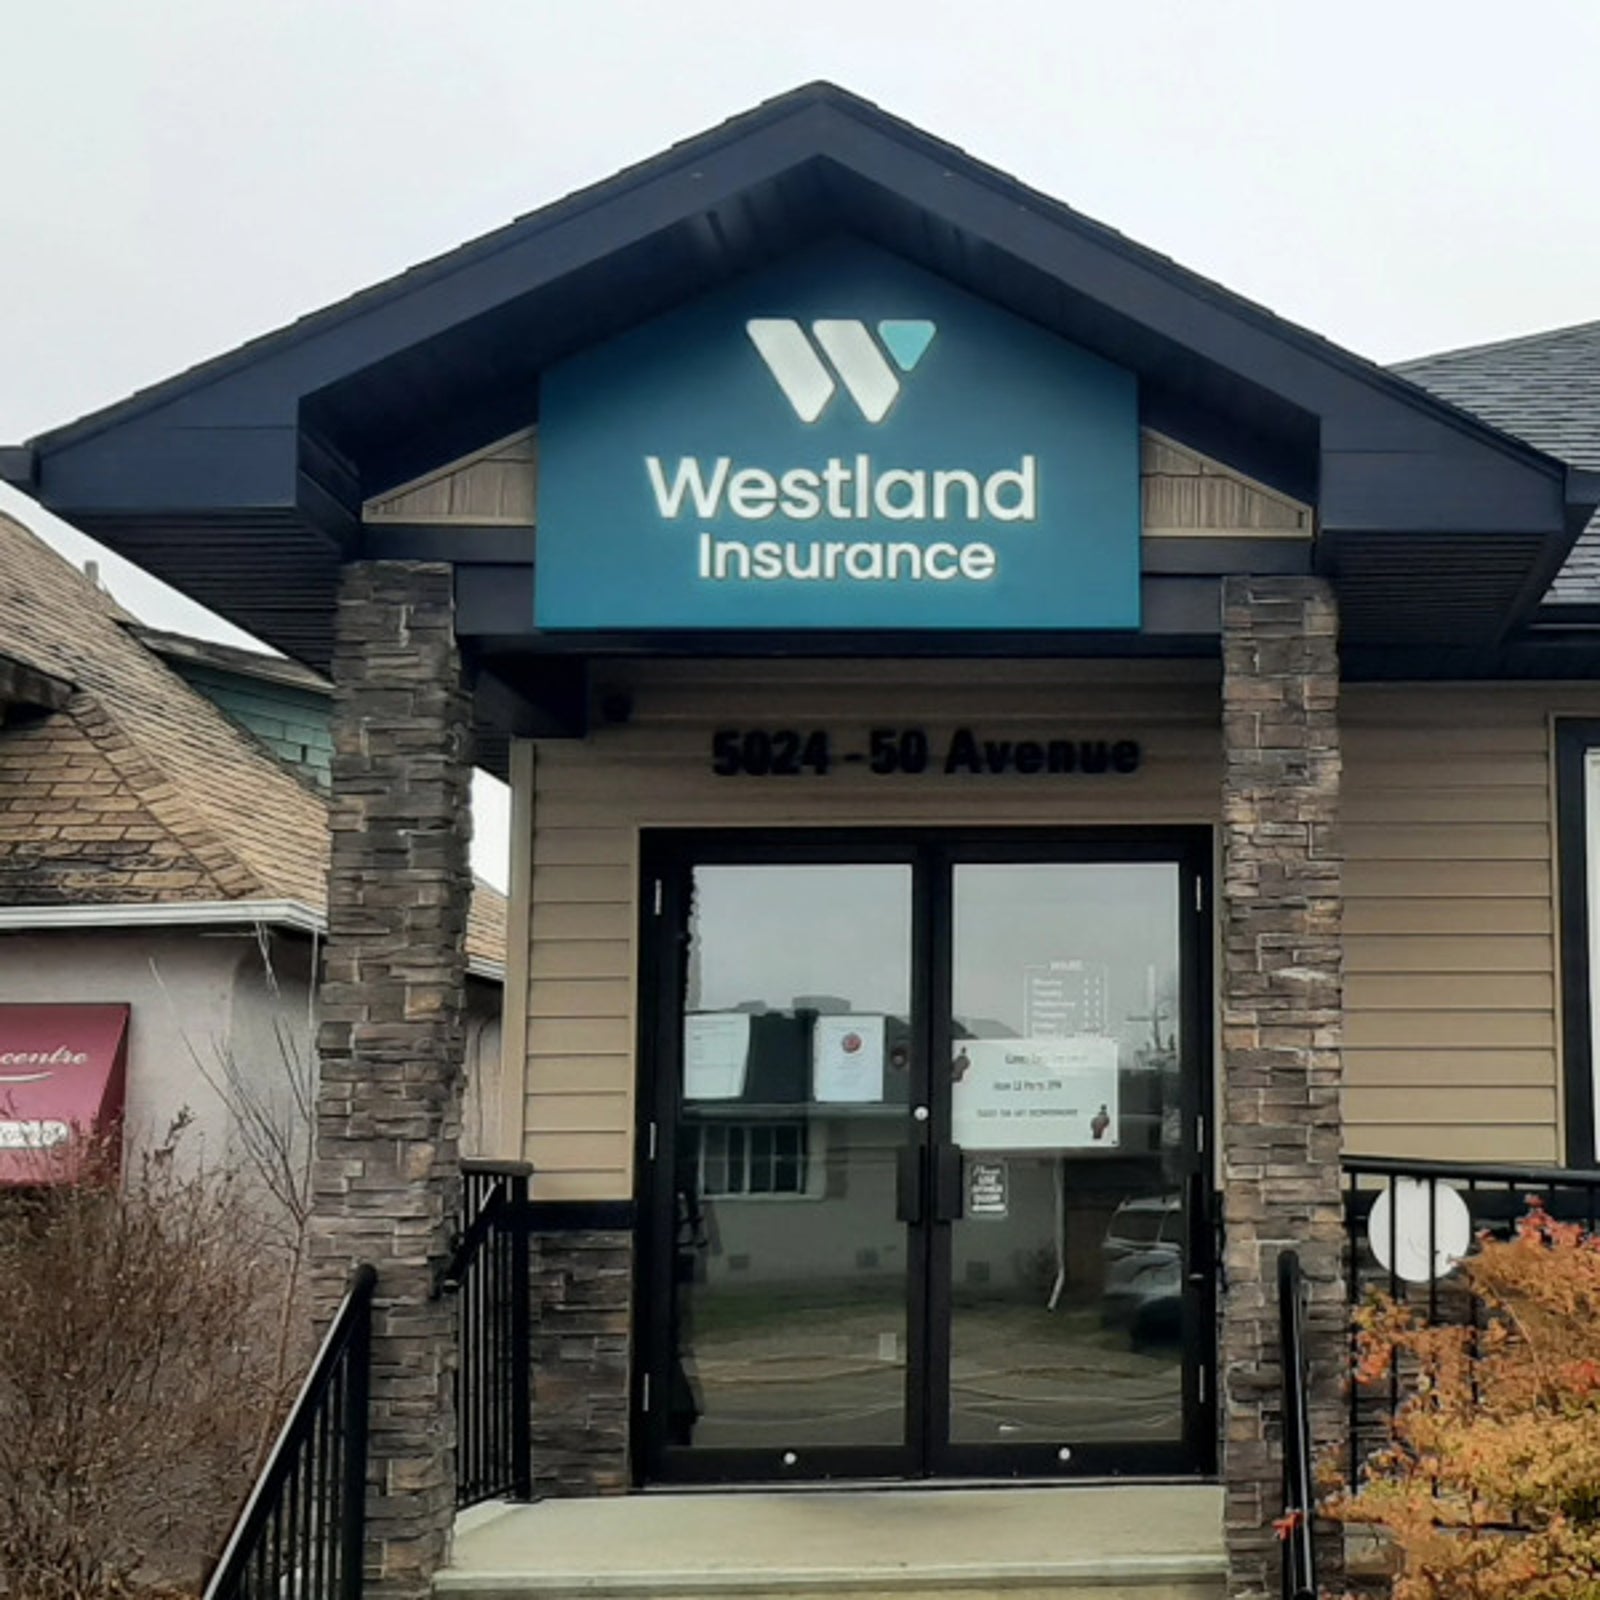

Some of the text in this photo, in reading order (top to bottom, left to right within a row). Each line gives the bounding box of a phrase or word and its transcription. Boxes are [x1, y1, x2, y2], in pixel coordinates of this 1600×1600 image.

[645, 454, 1037, 521] Westland
[699, 532, 996, 580] Insurance
[711, 729, 830, 776] 5024
[944, 727, 1140, 775] Avenue
